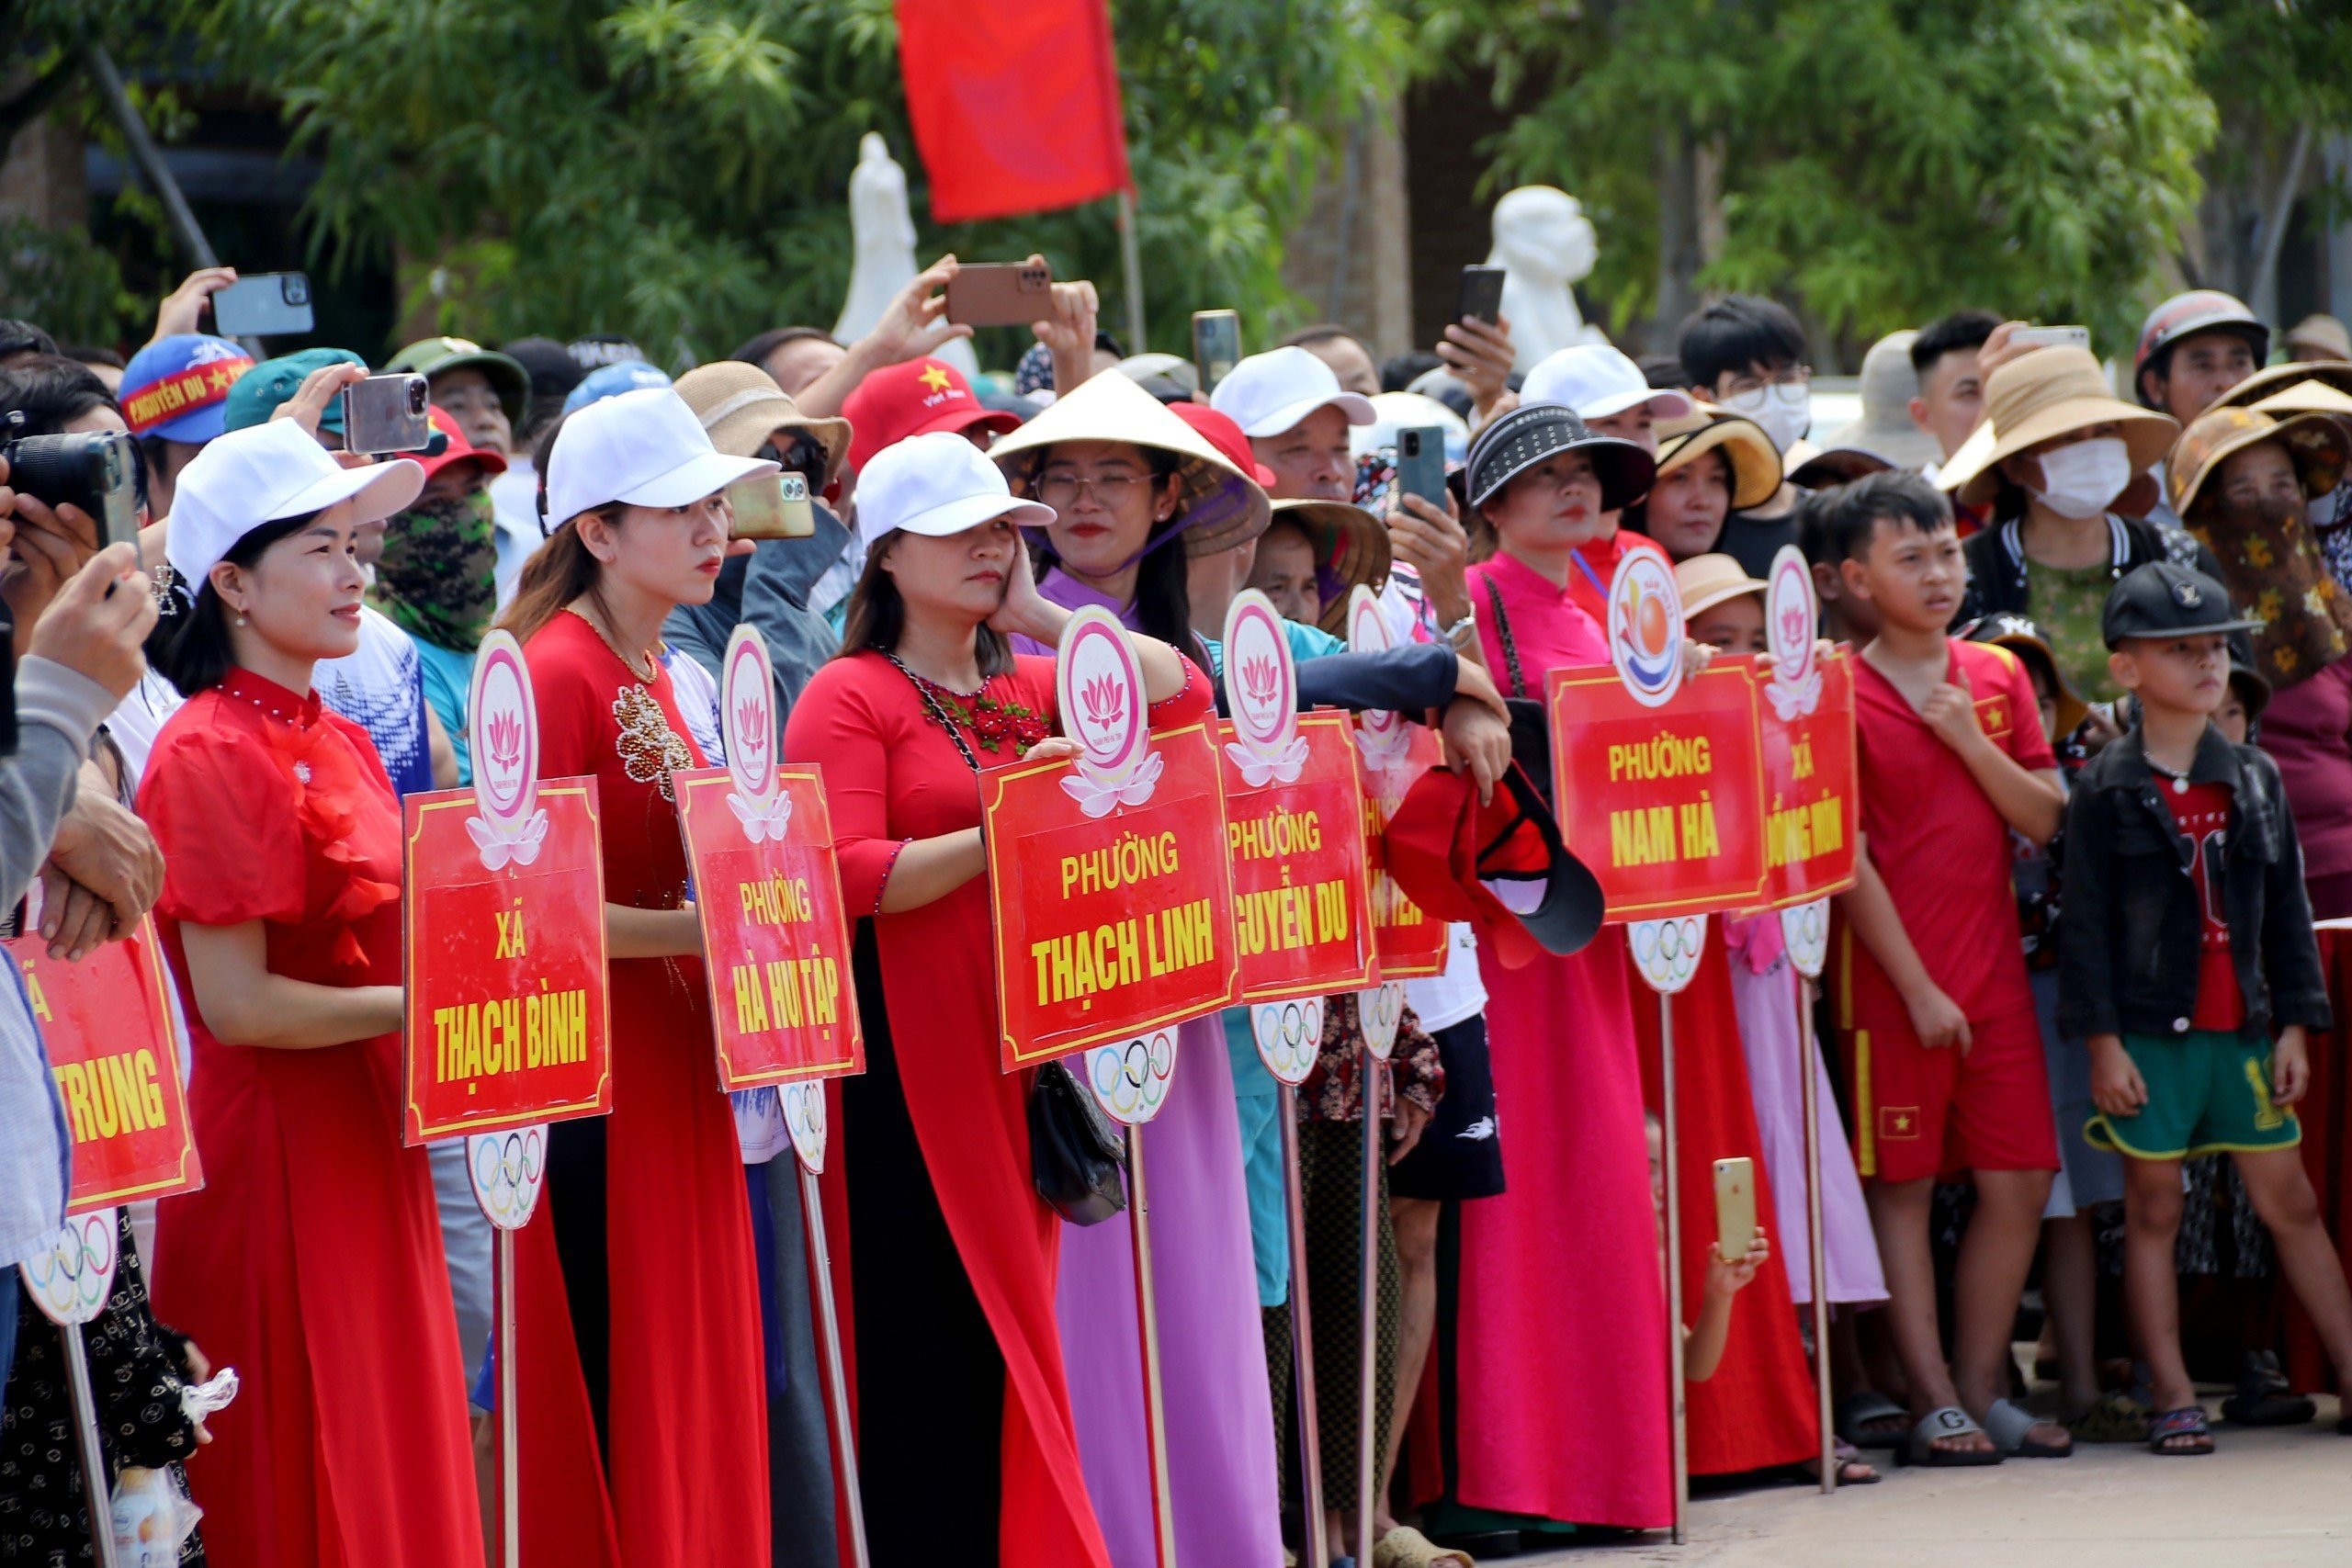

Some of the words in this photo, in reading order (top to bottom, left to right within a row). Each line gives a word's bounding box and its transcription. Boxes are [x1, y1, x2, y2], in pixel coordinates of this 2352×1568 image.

[182, 374, 208, 402] DU
[1609, 729, 1712, 783] PHƯỜNG
[1791, 732, 1815, 780] XÃ
[1228, 804, 1321, 862] PHƯỜNG
[1610, 805, 1677, 868] NAM
[1679, 788, 1721, 861] HÀ
[739, 867, 812, 927] PHƯỜNG
[1061, 829, 1179, 900] PHƯỜNG
[494, 897, 526, 960] XÃ
[1235, 864, 1314, 956] GUYỄN
[1315, 879, 1348, 944] DU
[1031, 918, 1142, 1011] THẠCH
[1146, 897, 1214, 978] LINH
[23, 958, 53, 1023] Ã
[732, 948, 770, 1035] HÀ
[799, 942, 839, 1041] TẬP
[434, 998, 521, 1096] THẠCH
[526, 976, 587, 1070] BÌNH
